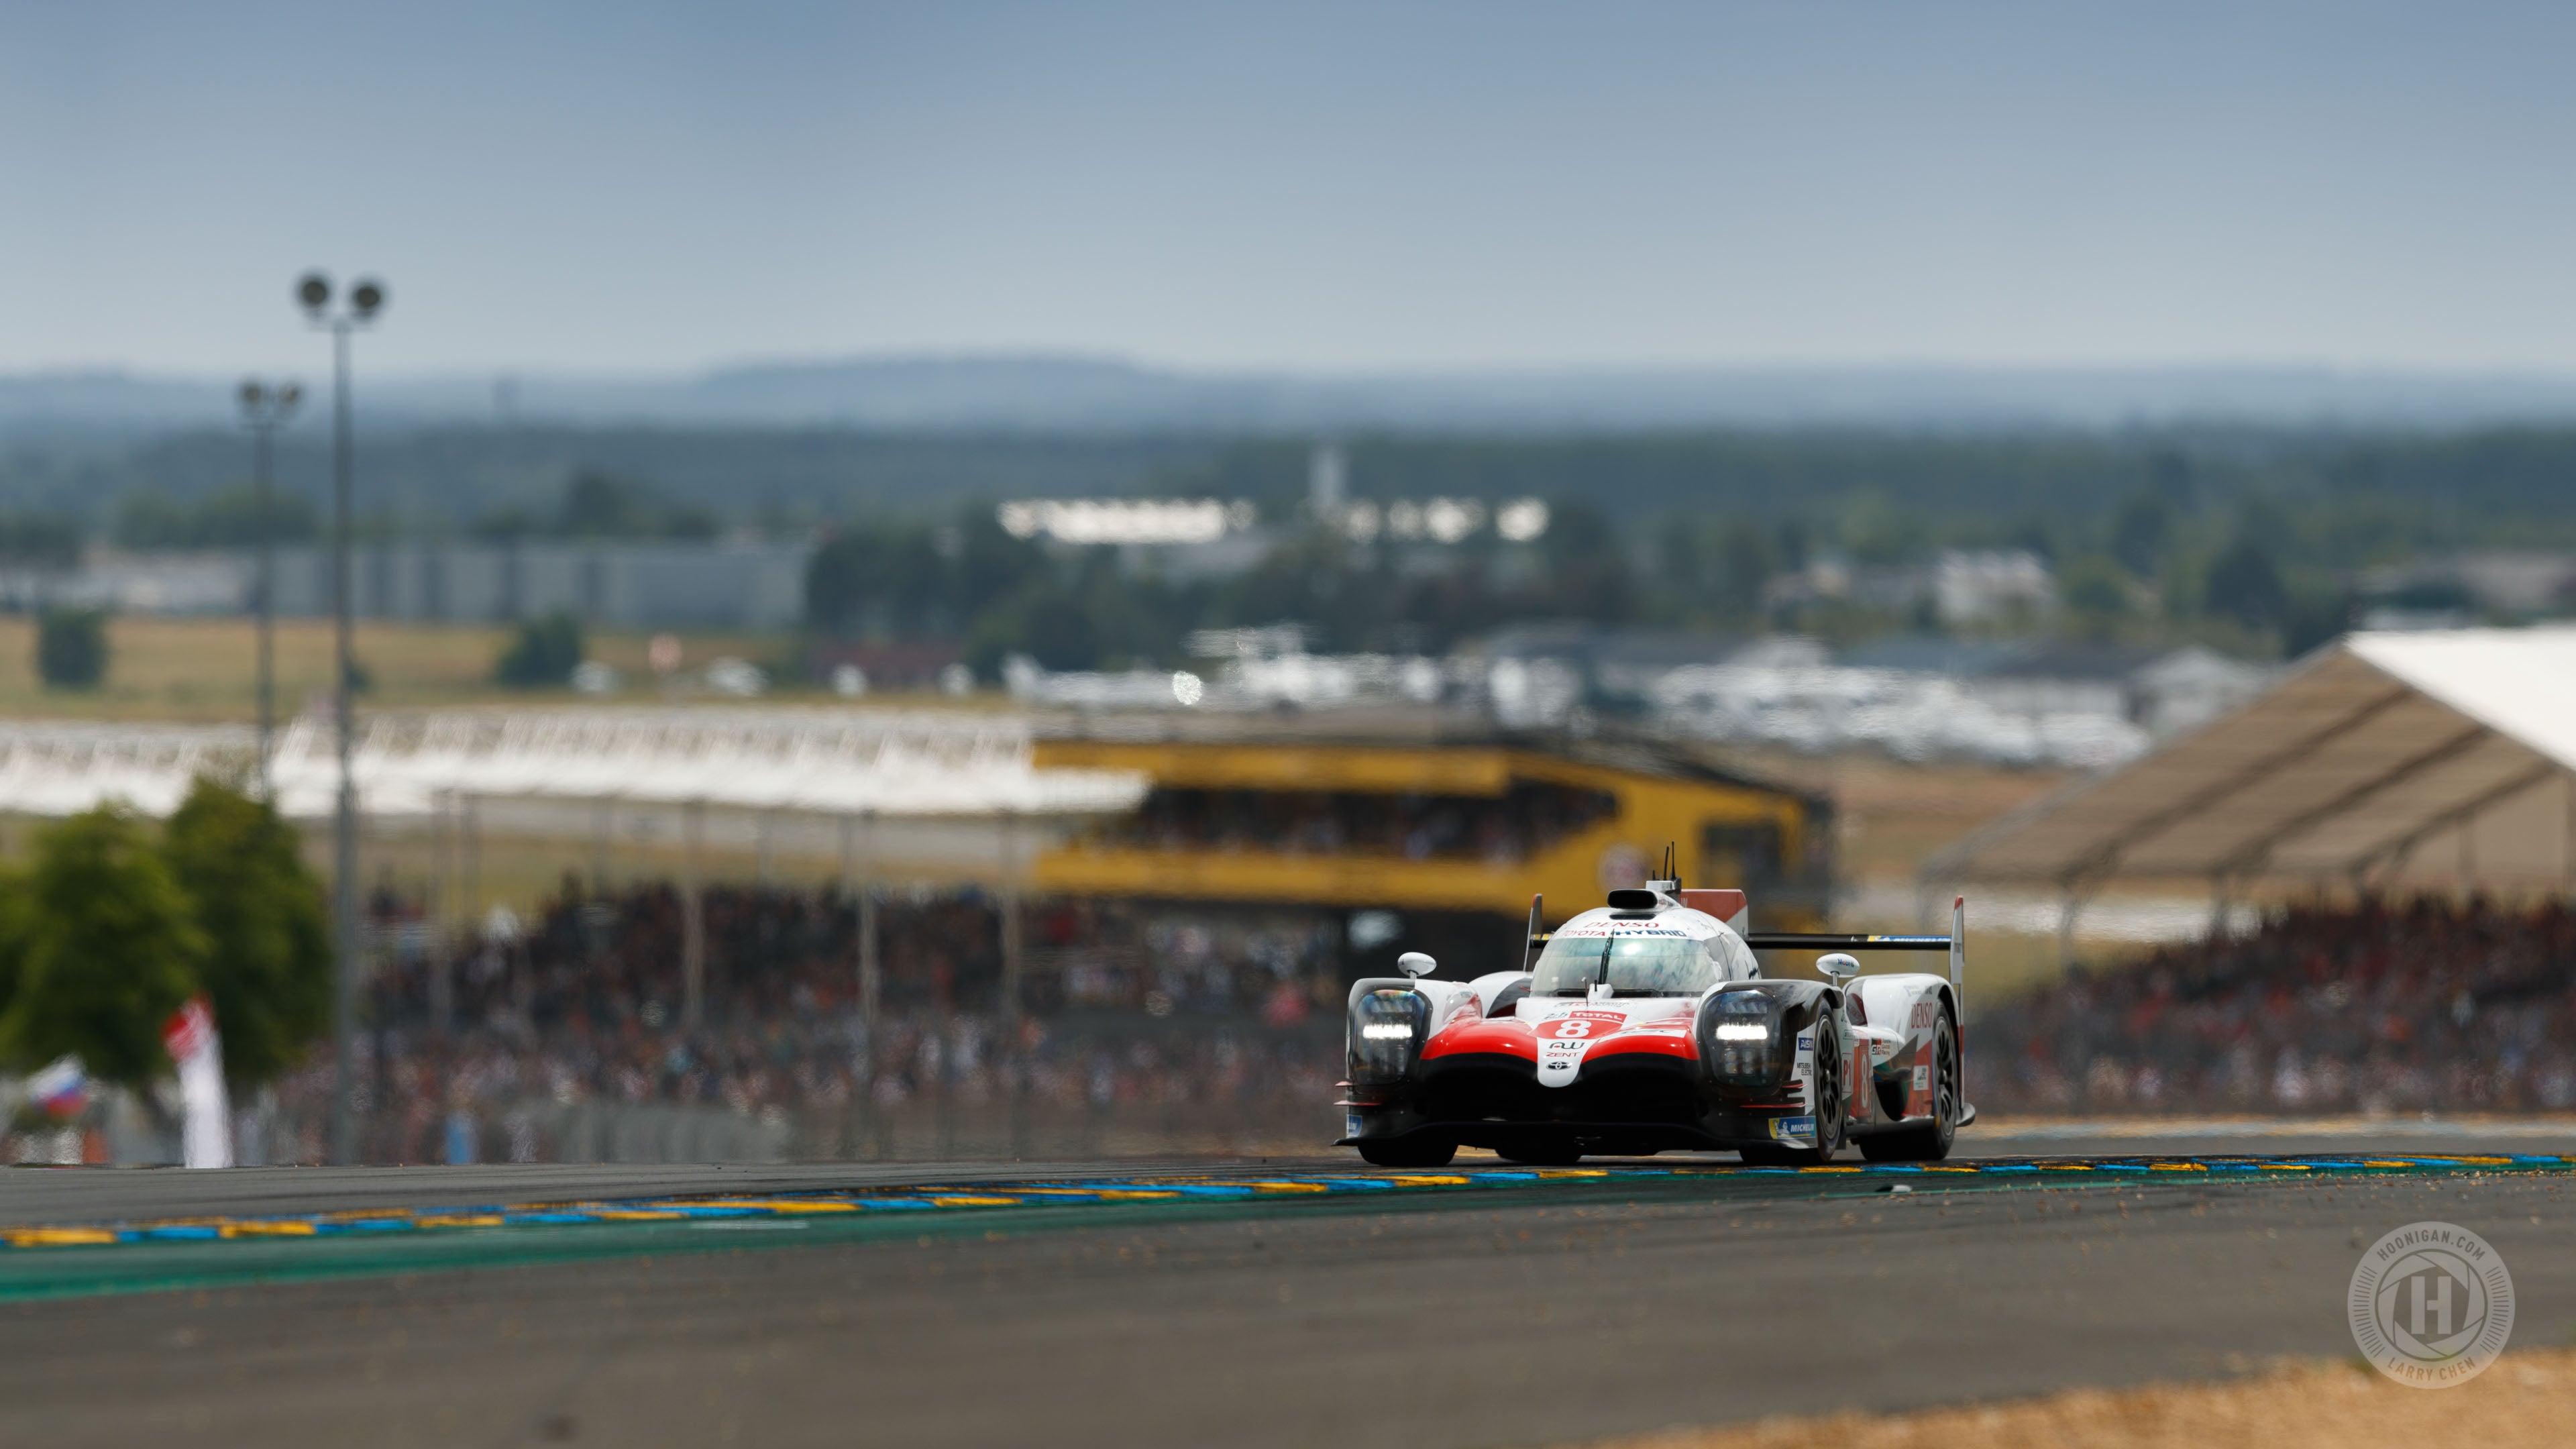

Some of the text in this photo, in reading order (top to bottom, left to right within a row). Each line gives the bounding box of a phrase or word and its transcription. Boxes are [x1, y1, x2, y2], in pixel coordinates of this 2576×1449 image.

[1573, 1012, 1623, 1020] TOTAL
[1911, 1002, 1933, 1029] DENSO
[1555, 1020, 1592, 1038] 8
[1862, 1054, 1869, 1109] 8
[1790, 1123, 1815, 1132] MICHELIN
